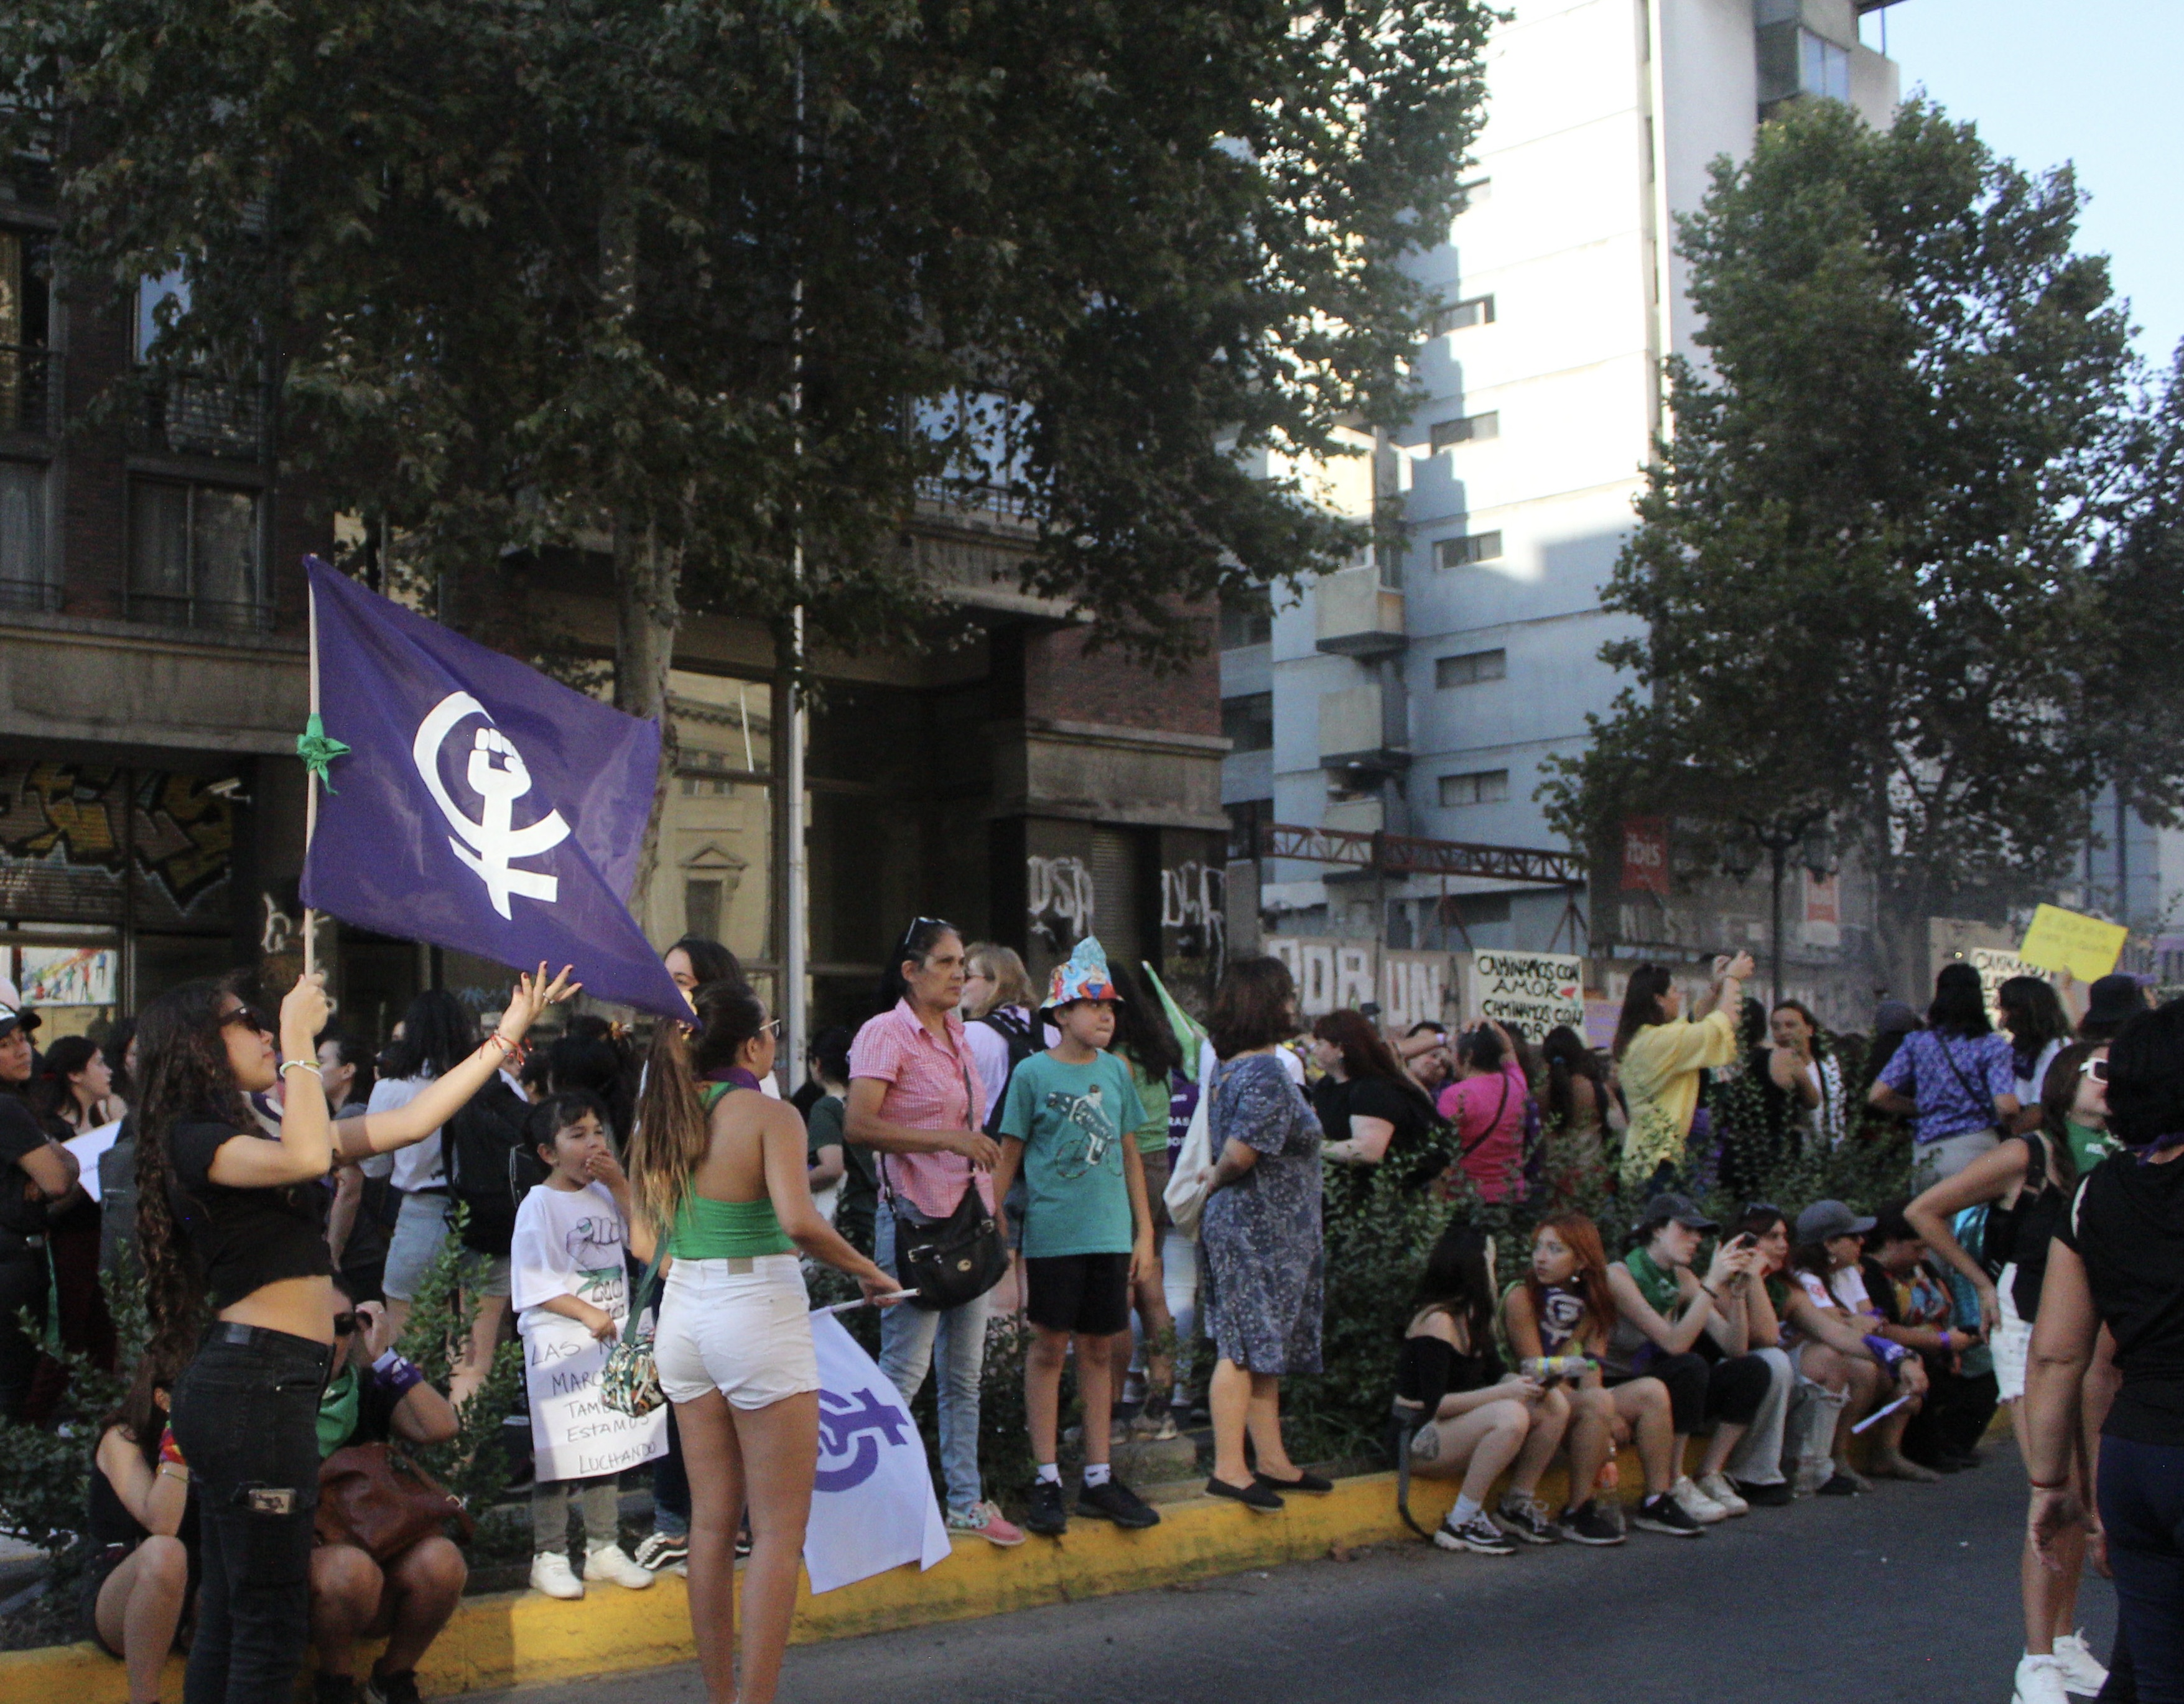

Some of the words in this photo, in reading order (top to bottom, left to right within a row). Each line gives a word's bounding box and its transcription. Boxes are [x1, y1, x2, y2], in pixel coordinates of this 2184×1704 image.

[1492, 979, 1563, 1000] AMOR
[1554, 1007, 1583, 1026] CON
[531, 1341, 580, 1366] LAS
[579, 1441, 656, 1474] LUCHANDO
